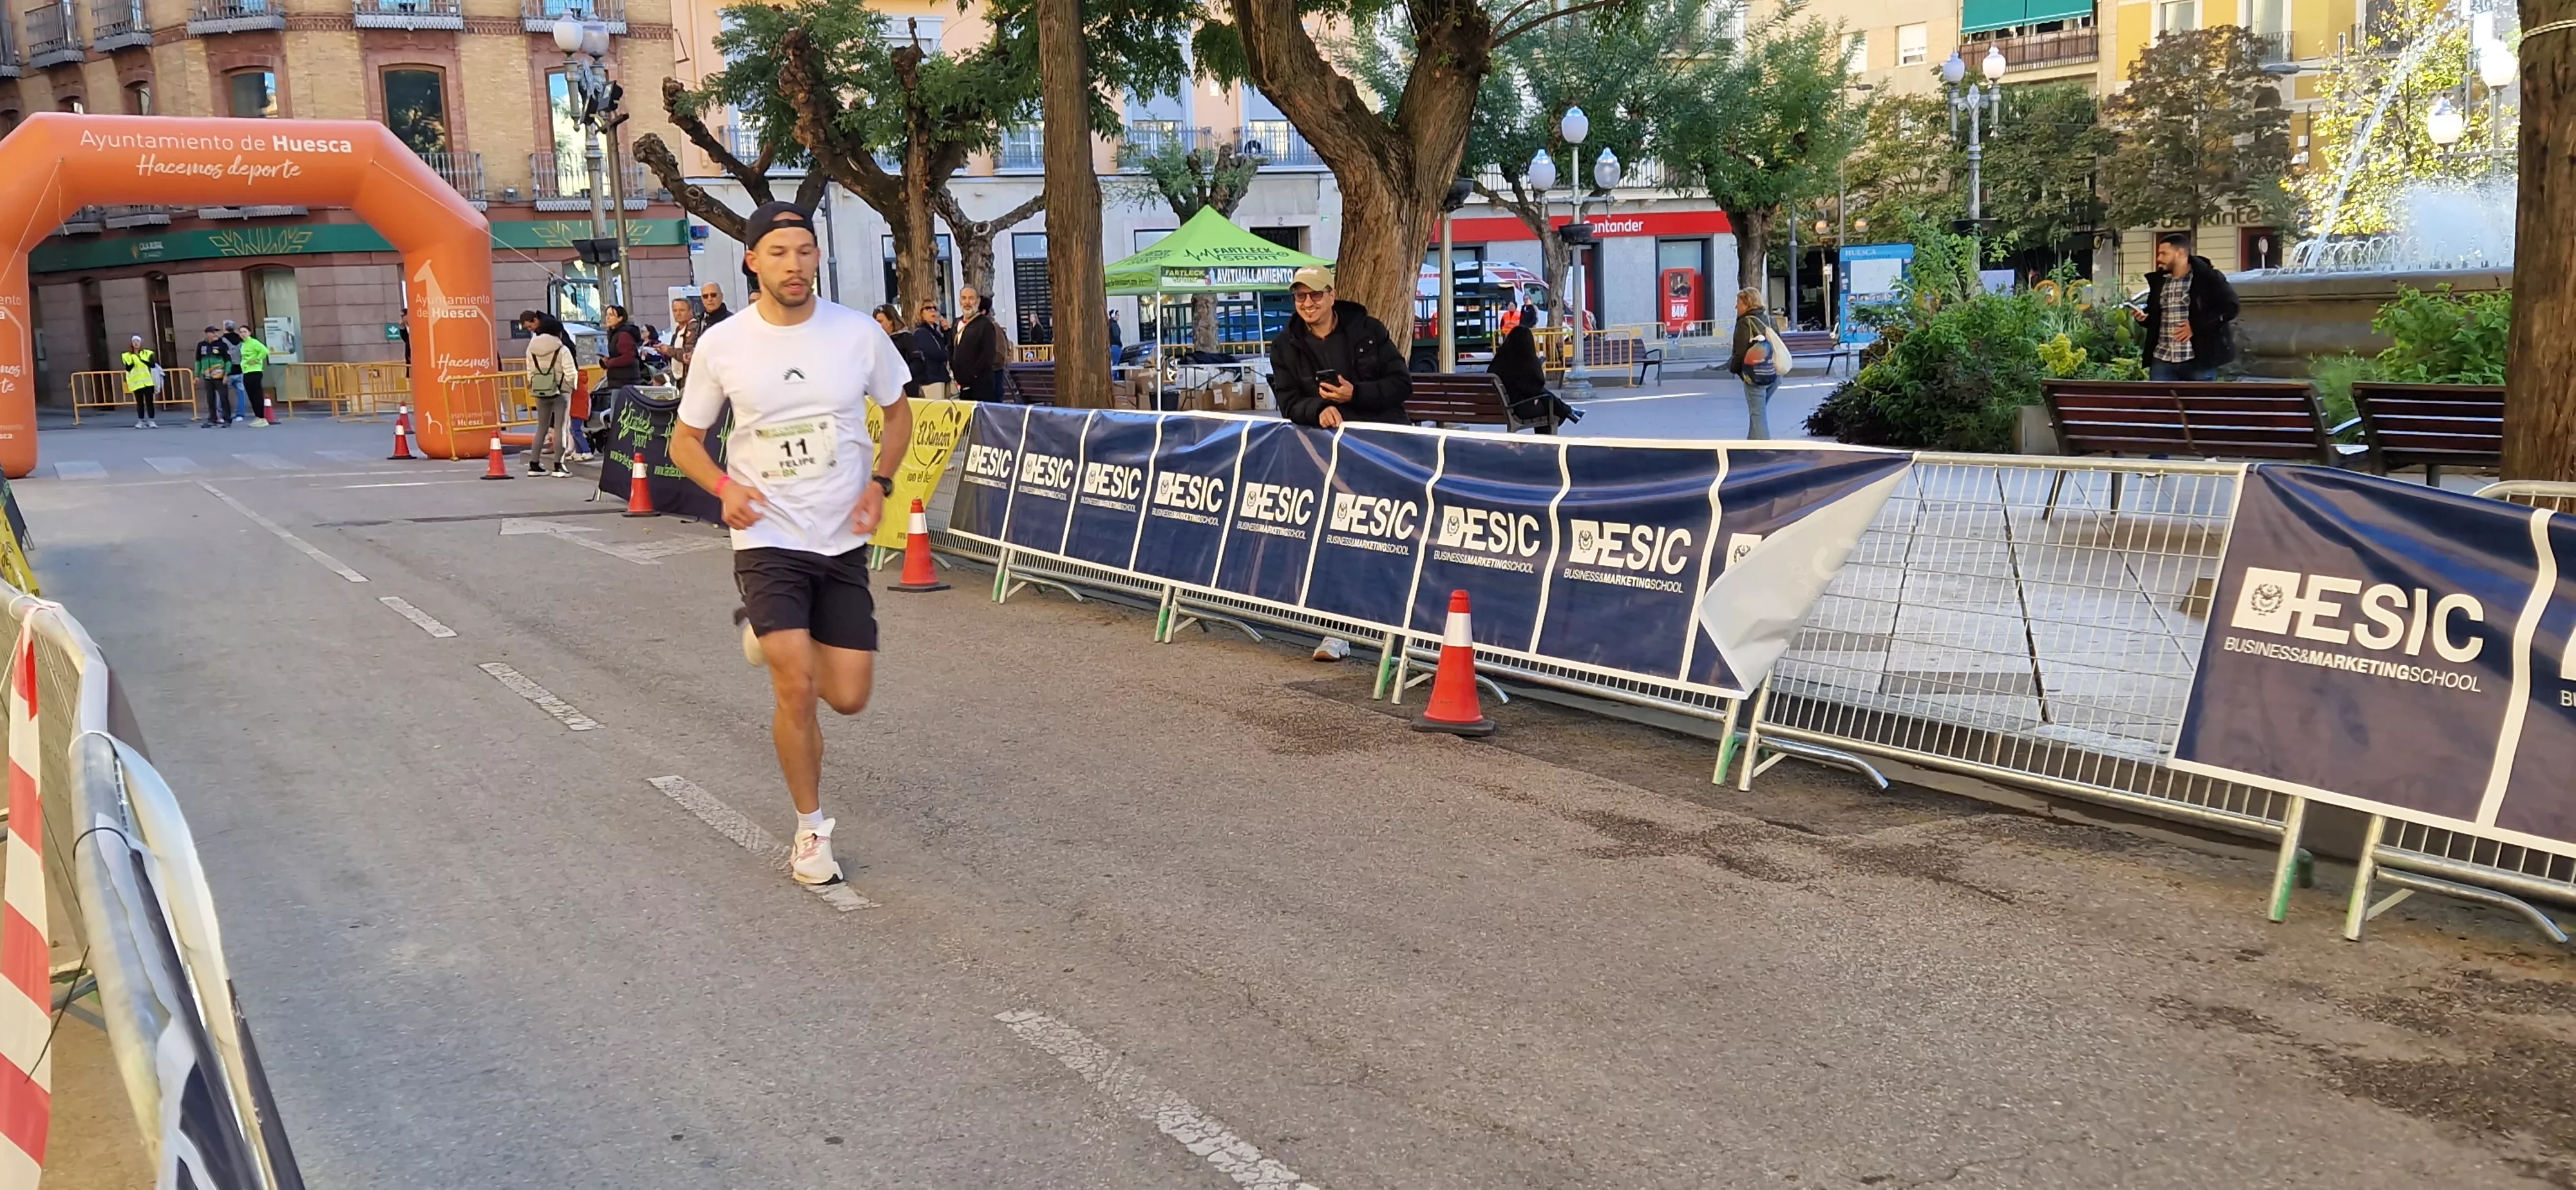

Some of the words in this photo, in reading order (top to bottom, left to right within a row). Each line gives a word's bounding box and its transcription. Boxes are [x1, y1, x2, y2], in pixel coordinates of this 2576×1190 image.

[80, 129, 233, 151] Ayuntamiento
[241, 135, 265, 151] de
[272, 135, 352, 153] Huesca
[136, 153, 224, 179] Hacemos
[227, 155, 302, 185] deporte
[1278, 216, 1283, 225] 2
[1213, 247, 1273, 255] FARTLECK
[1217, 268, 1294, 284] AVITUALLAMIENTO
[415, 293, 490, 306] Ayuntamiento
[417, 308, 428, 318] de
[432, 308, 478, 319] Huesca
[437, 353, 490, 369] Hacemos
[916, 420, 927, 446] El
[926, 420, 951, 447] Rincón
[780, 438, 808, 457] 11
[779, 457, 817, 468] FELIPE
[976, 445, 1013, 479] ESIC
[1032, 454, 1074, 489] ESIC
[1096, 463, 1142, 500] ESIC
[1170, 473, 1224, 513] ESIC
[1257, 484, 1314, 525] ESIC
[1350, 495, 1418, 540] ESIC
[1326, 534, 1410, 556] BUSINESS&MARKETINGSCHOOL
[1462, 507, 1540, 558] ESIC
[1434, 549, 1535, 574] BUSINESS&MARKETINGSCHOOL
[1597, 522, 1692, 574] ESIC
[1563, 567, 1685, 594] BUSINESS&MARKETINGSCHOOL
[2294, 574, 2485, 663] ESIC
[2222, 636, 2482, 694] BUSINESS&MARKETINGSCHOOL
